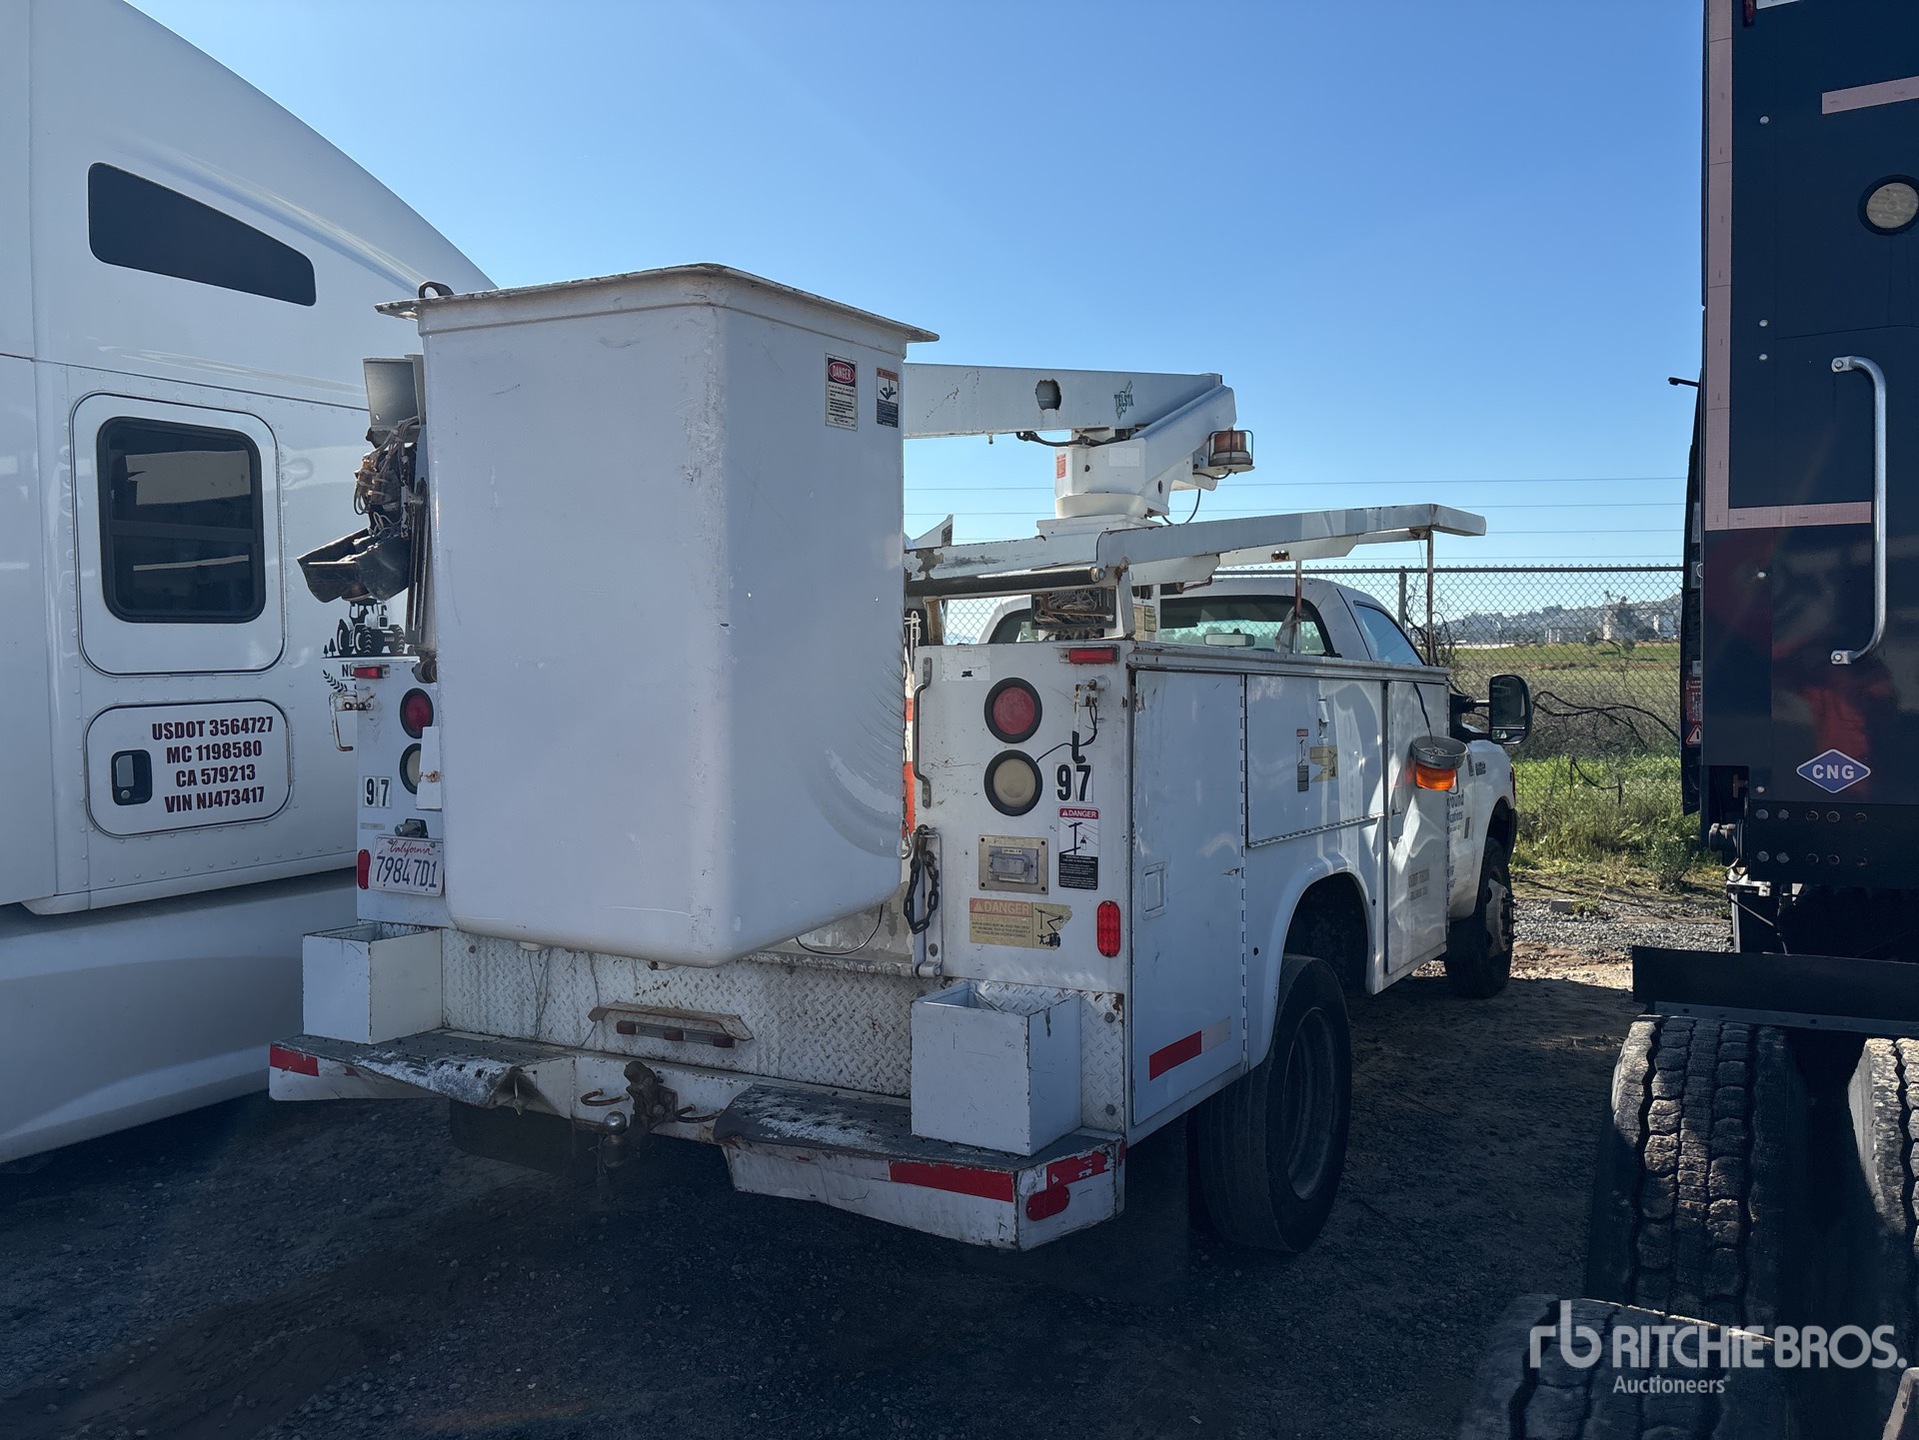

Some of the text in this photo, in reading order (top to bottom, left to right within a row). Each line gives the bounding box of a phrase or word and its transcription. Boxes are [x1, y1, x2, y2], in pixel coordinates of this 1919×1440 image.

[152, 716, 274, 740] USDOT 3564727
[166, 740, 263, 764] MC 1198580
[175, 764, 256, 788] CA 579213
[1056, 764, 1092, 802] 97
[1812, 764, 1855, 780] CNG
[164, 786, 265, 813] VIN NJ473417
[366, 778, 390, 807] 97
[1068, 809, 1098, 818] DANGER
[389, 840, 433, 858] California
[376, 855, 438, 888] 79847D1
[984, 900, 1031, 915] DANGER
